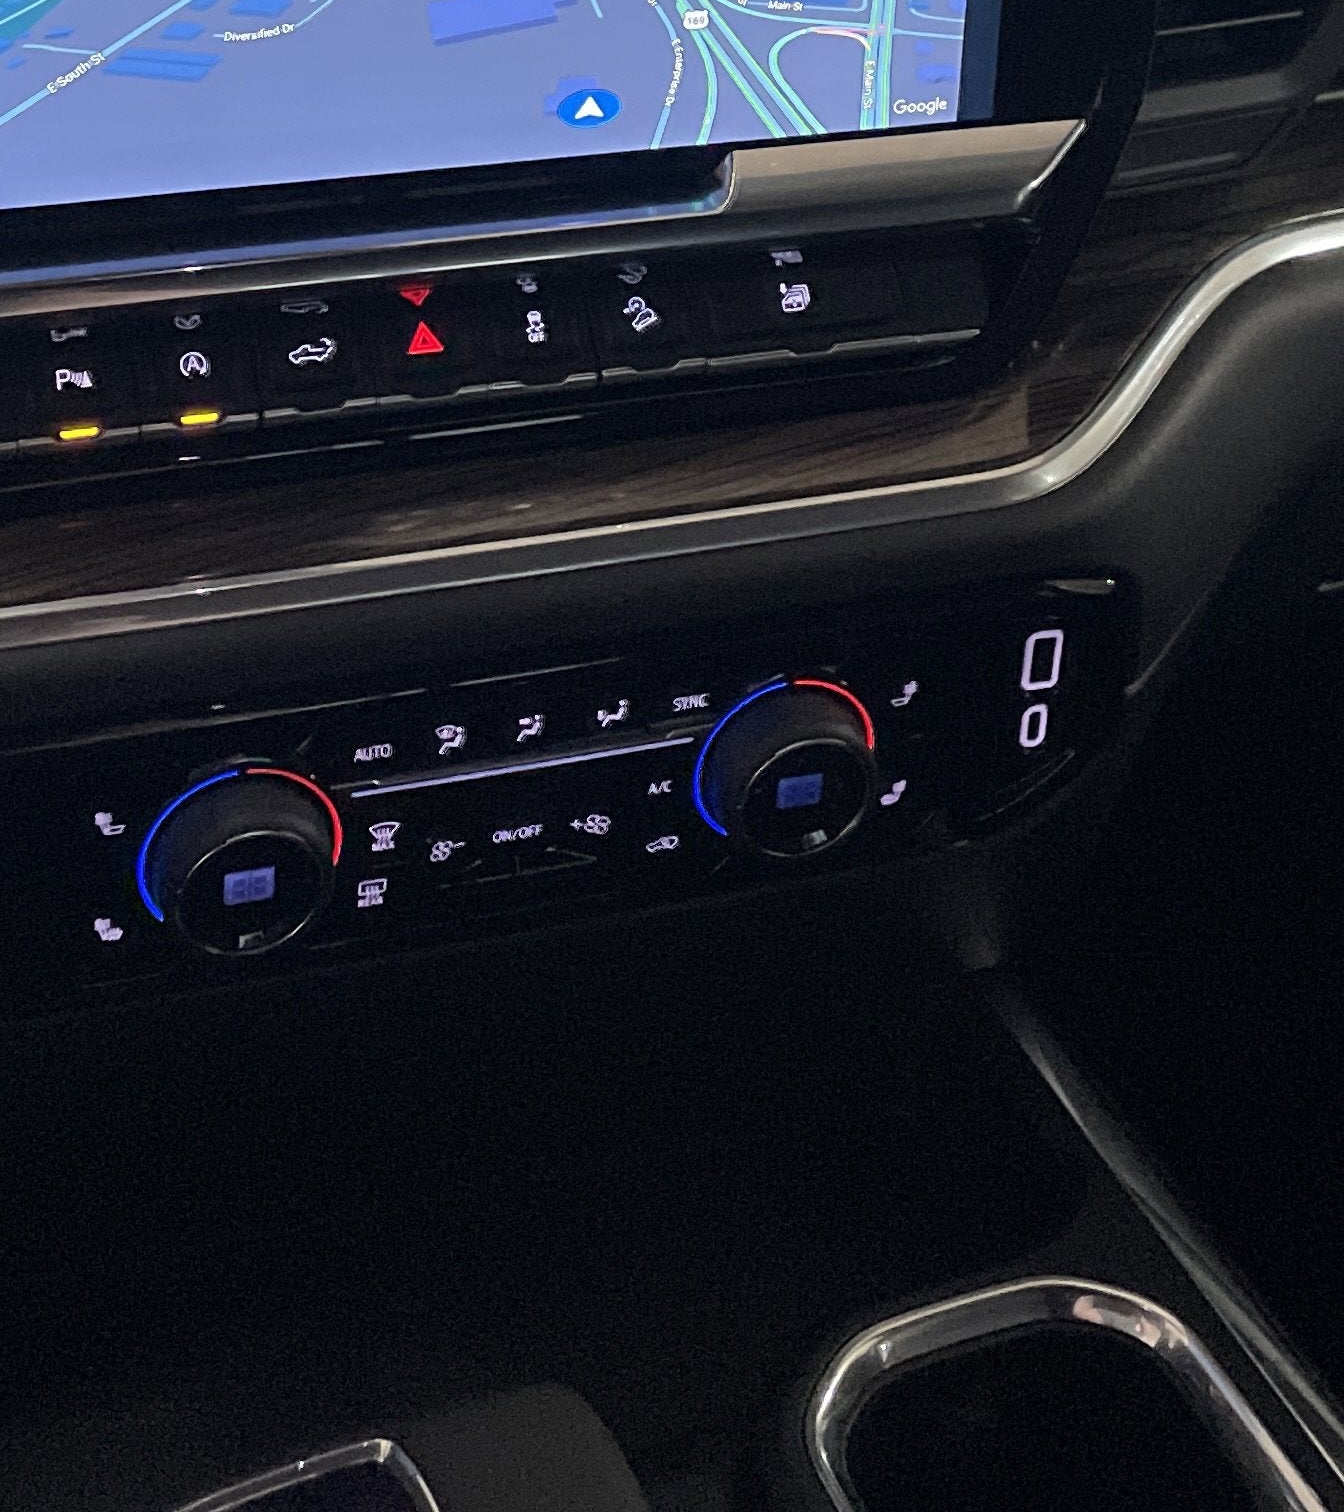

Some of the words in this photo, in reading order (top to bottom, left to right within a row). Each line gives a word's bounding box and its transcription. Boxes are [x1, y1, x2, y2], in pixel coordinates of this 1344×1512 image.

[768, 0, 790, 10] Main
[793, 2, 803, 12] St
[687, 16, 705, 25] 169
[223, 28, 280, 42] Diversified
[282, 23, 295, 34] Dr
[47, 82, 58, 94] E
[56, 61, 91, 88] South
[89, 51, 105, 66] St
[668, 45, 684, 97] Enterprise
[864, 69, 874, 96] Main
[863, 98, 873, 109] St
[893, 97, 948, 115] Google
[672, 693, 711, 712] SYNC
[354, 743, 394, 762] AUTO
[648, 778, 672, 795] A/C
[492, 824, 543, 843] ON/OFF
